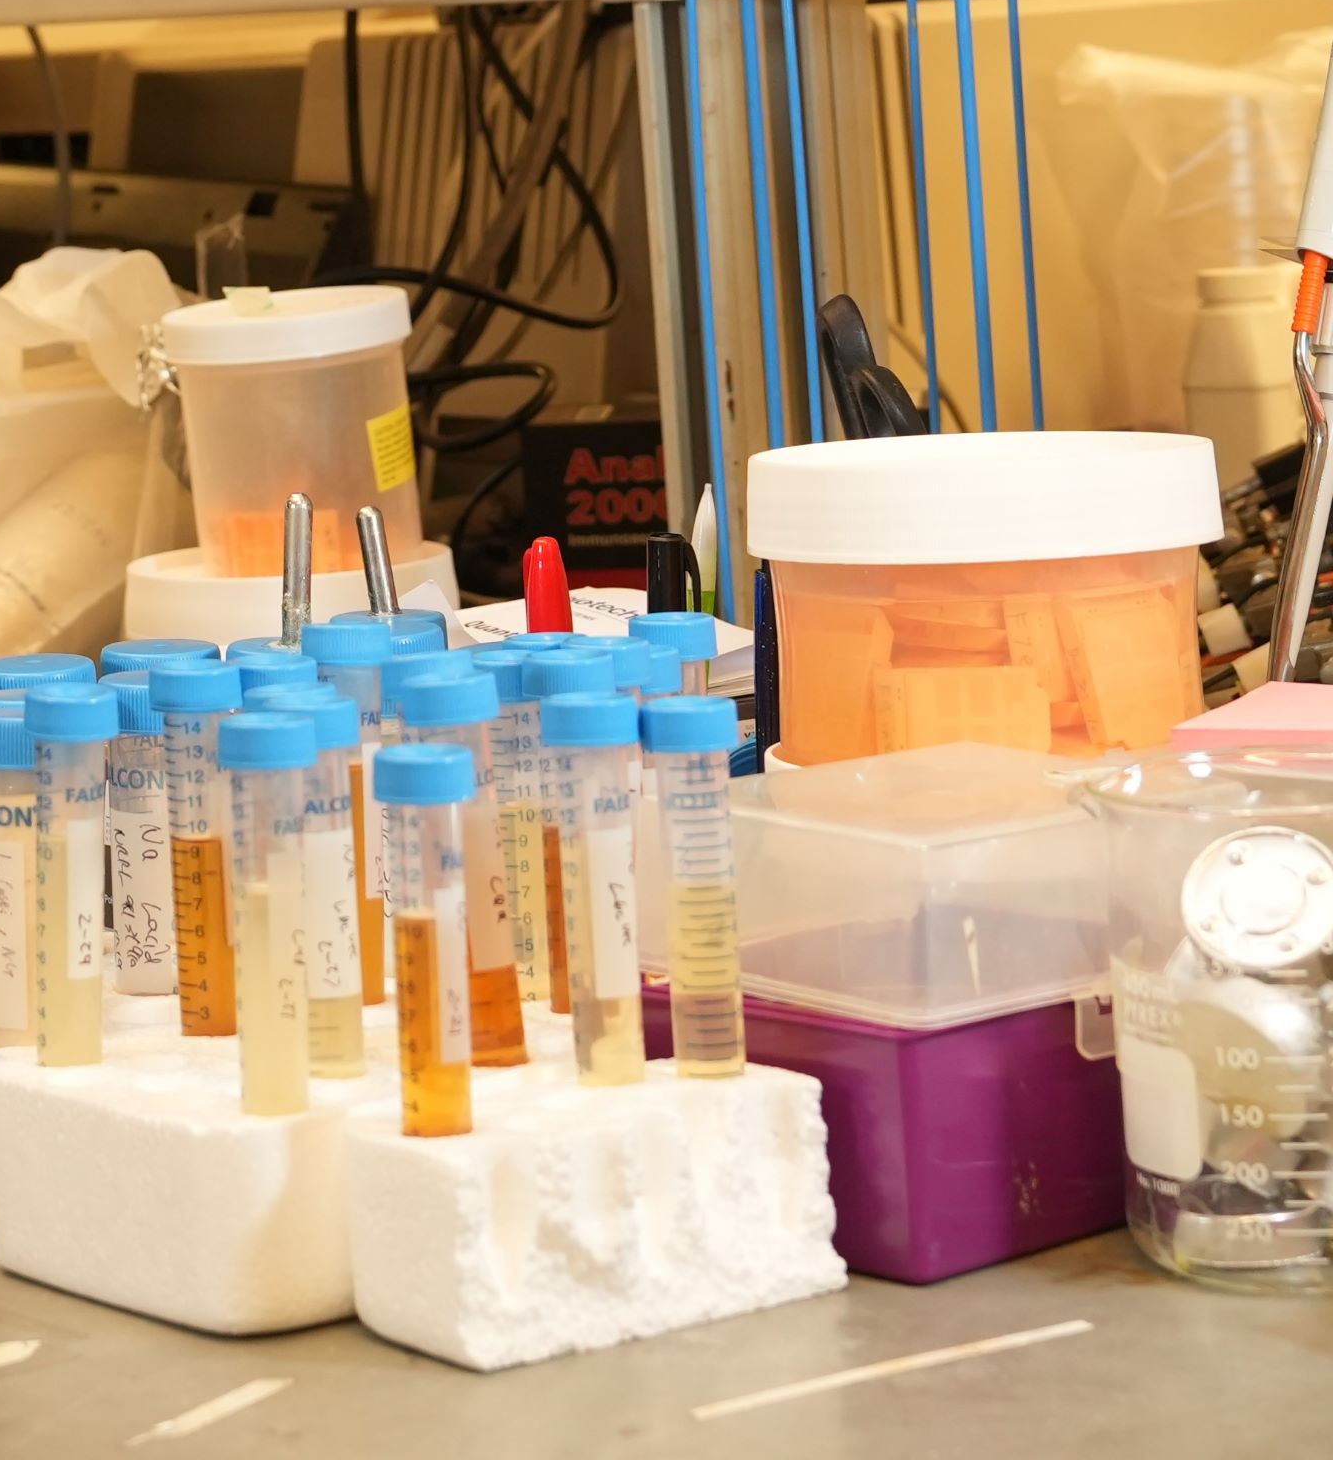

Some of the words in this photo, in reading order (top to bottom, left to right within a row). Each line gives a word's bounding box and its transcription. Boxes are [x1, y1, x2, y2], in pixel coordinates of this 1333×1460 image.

[512, 712, 530, 725] 14
[184, 722, 201, 734] 14
[513, 737, 532, 749] 13
[185, 745, 203, 758] 13
[515, 760, 533, 772] 12
[186, 771, 204, 784] 12
[517, 785, 532, 797] 11
[187, 795, 203, 808] 11
[518, 810, 535, 822] 10
[189, 820, 207, 832] 10
[519, 834, 528, 847] 9
[190, 846, 200, 858] 9
[521, 860, 530, 872] 8
[191, 872, 202, 885] 8
[521, 885, 530, 898] 7
[193, 898, 203, 910] 7
[523, 912, 532, 925] 6
[195, 925, 205, 938] 6
[524, 940, 533, 951] 5
[197, 952, 207, 964] 5
[525, 966, 534, 978] 4
[197, 980, 208, 991] 4
[200, 1007, 210, 1019] 3
[1215, 1046, 1260, 1069] 100
[1220, 1104, 1264, 1127] 150
[1221, 1161, 1270, 1183] 200
